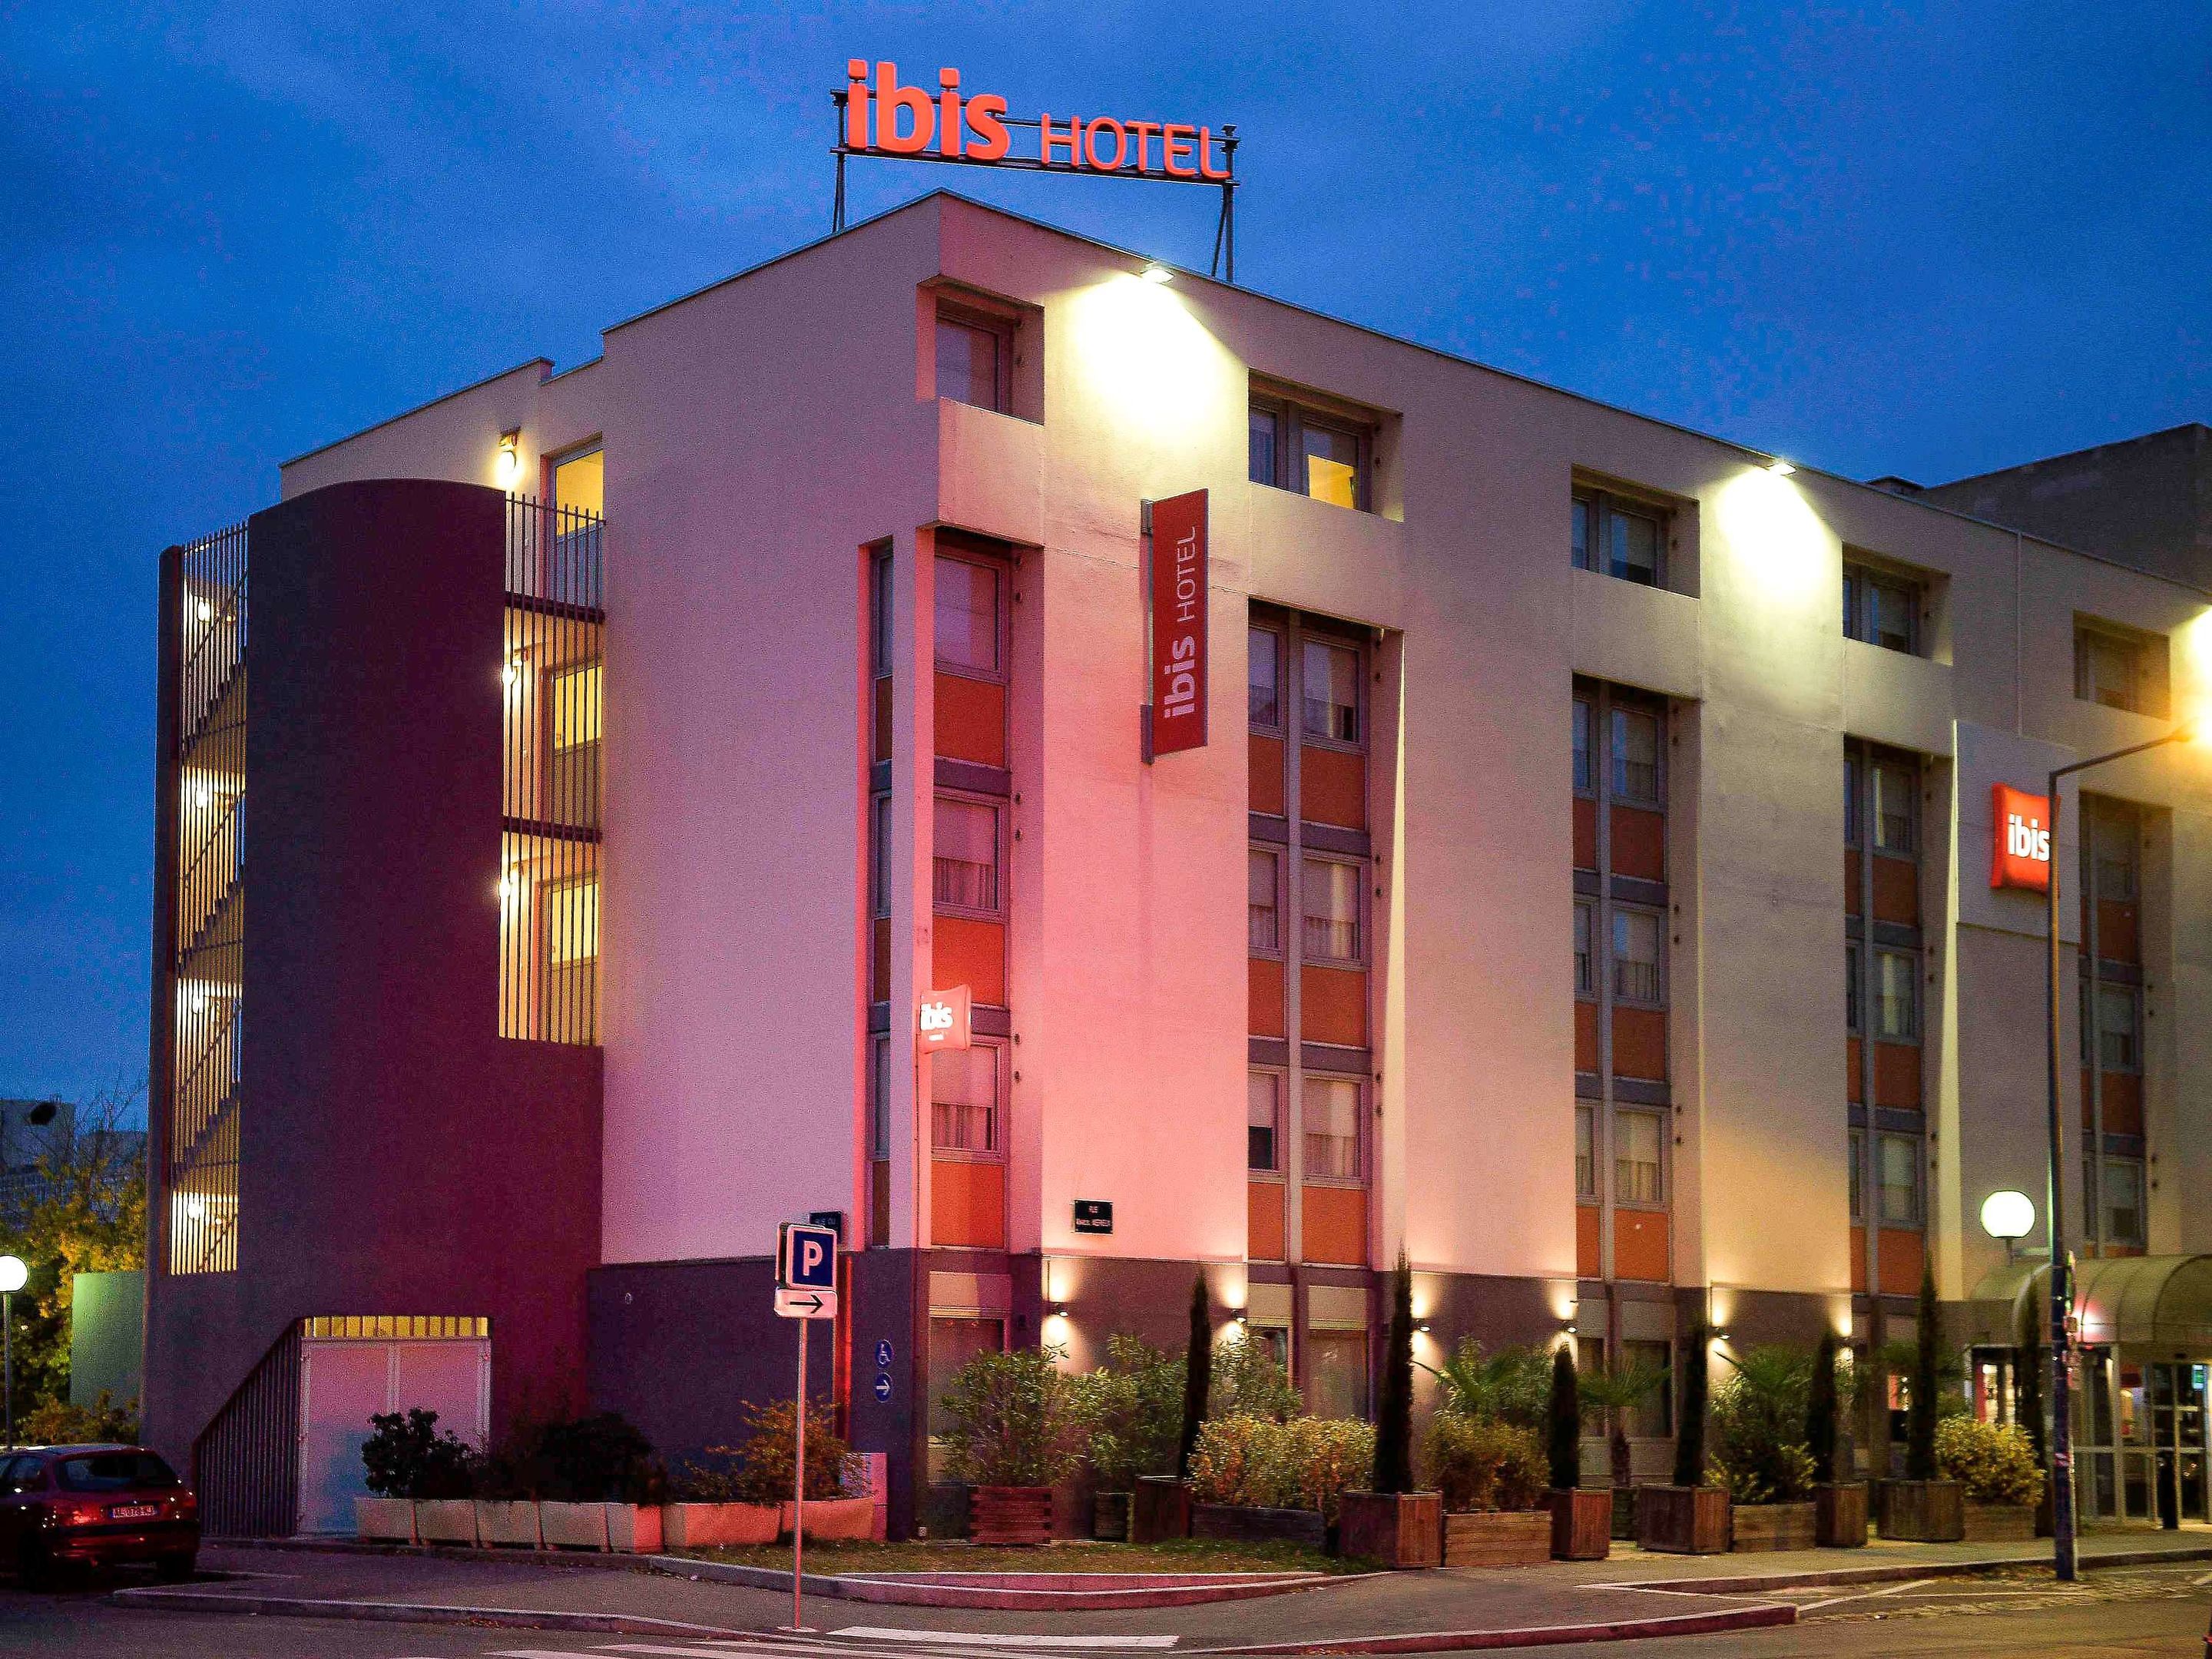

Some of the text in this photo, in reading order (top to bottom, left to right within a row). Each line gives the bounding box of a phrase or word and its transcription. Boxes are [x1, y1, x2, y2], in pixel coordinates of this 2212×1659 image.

[847, 58, 1230, 180] ibis HOTEL
[1164, 526, 1197, 718] ibis HOTEL
[2008, 813, 2050, 862] ibis
[920, 1002, 954, 1031] ibis
[803, 1240, 823, 1276] P
